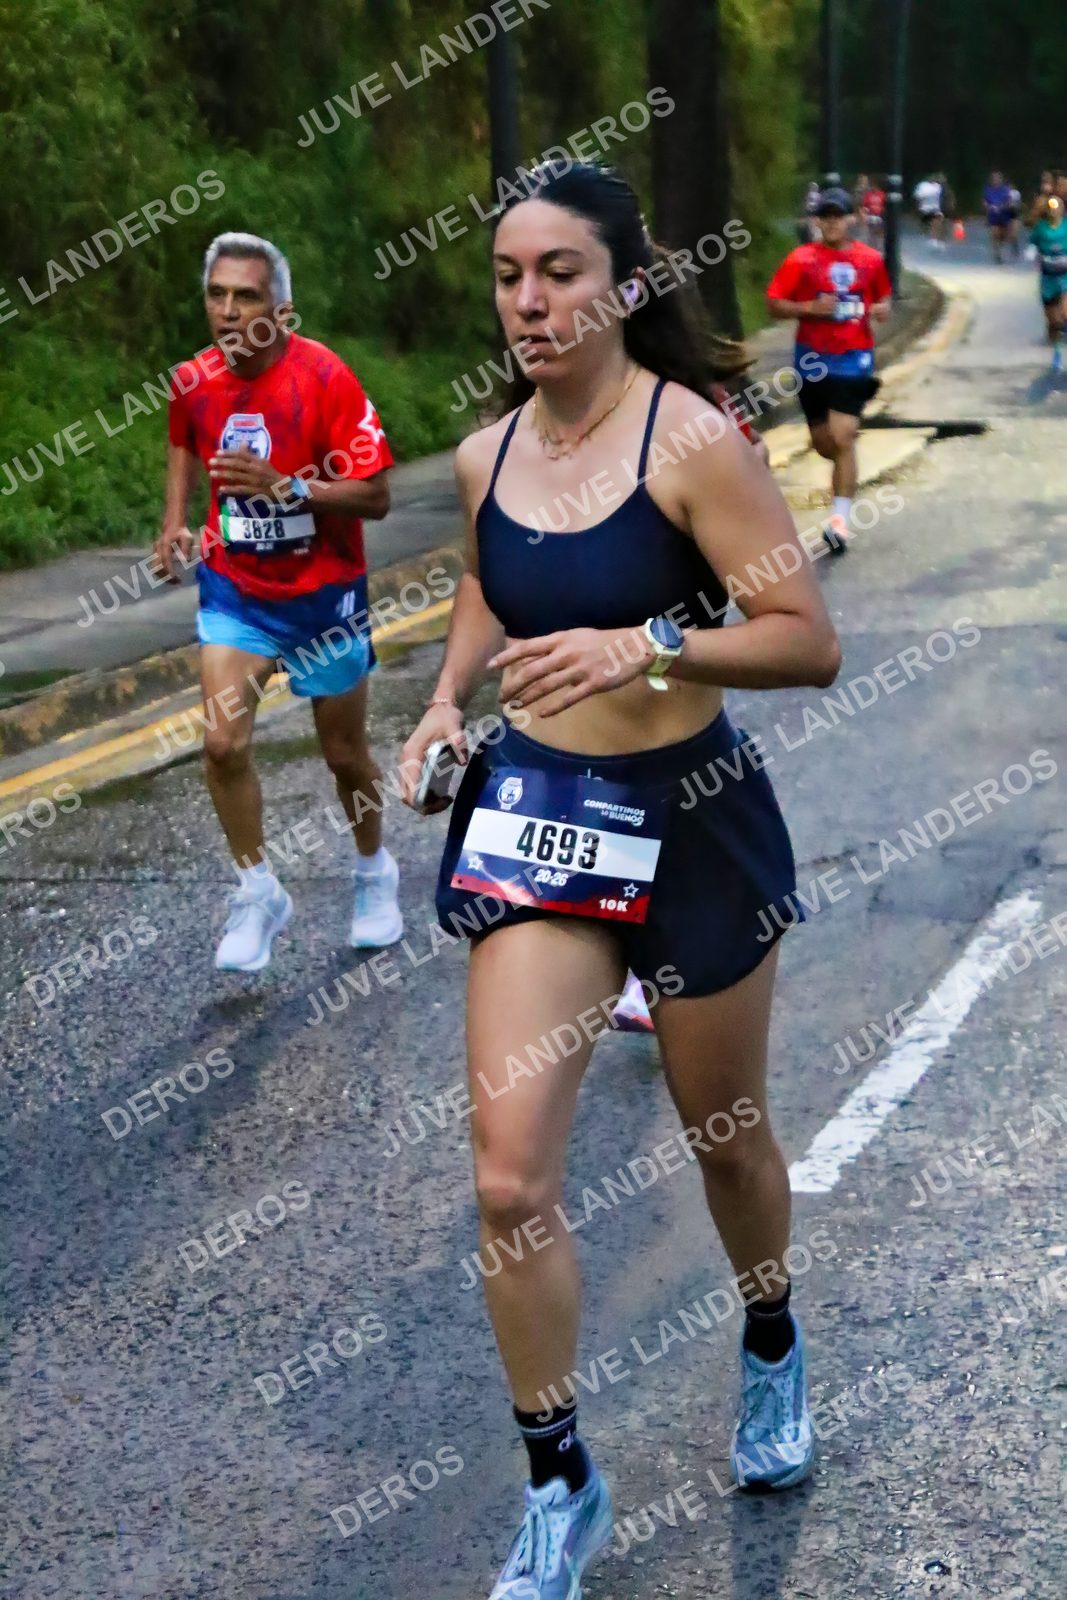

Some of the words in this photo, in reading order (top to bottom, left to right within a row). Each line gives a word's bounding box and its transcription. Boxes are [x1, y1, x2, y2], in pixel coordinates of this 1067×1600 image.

[243, 519, 286, 539] 3828
[516, 820, 600, 870] 4693
[599, 898, 629, 913] 10K
